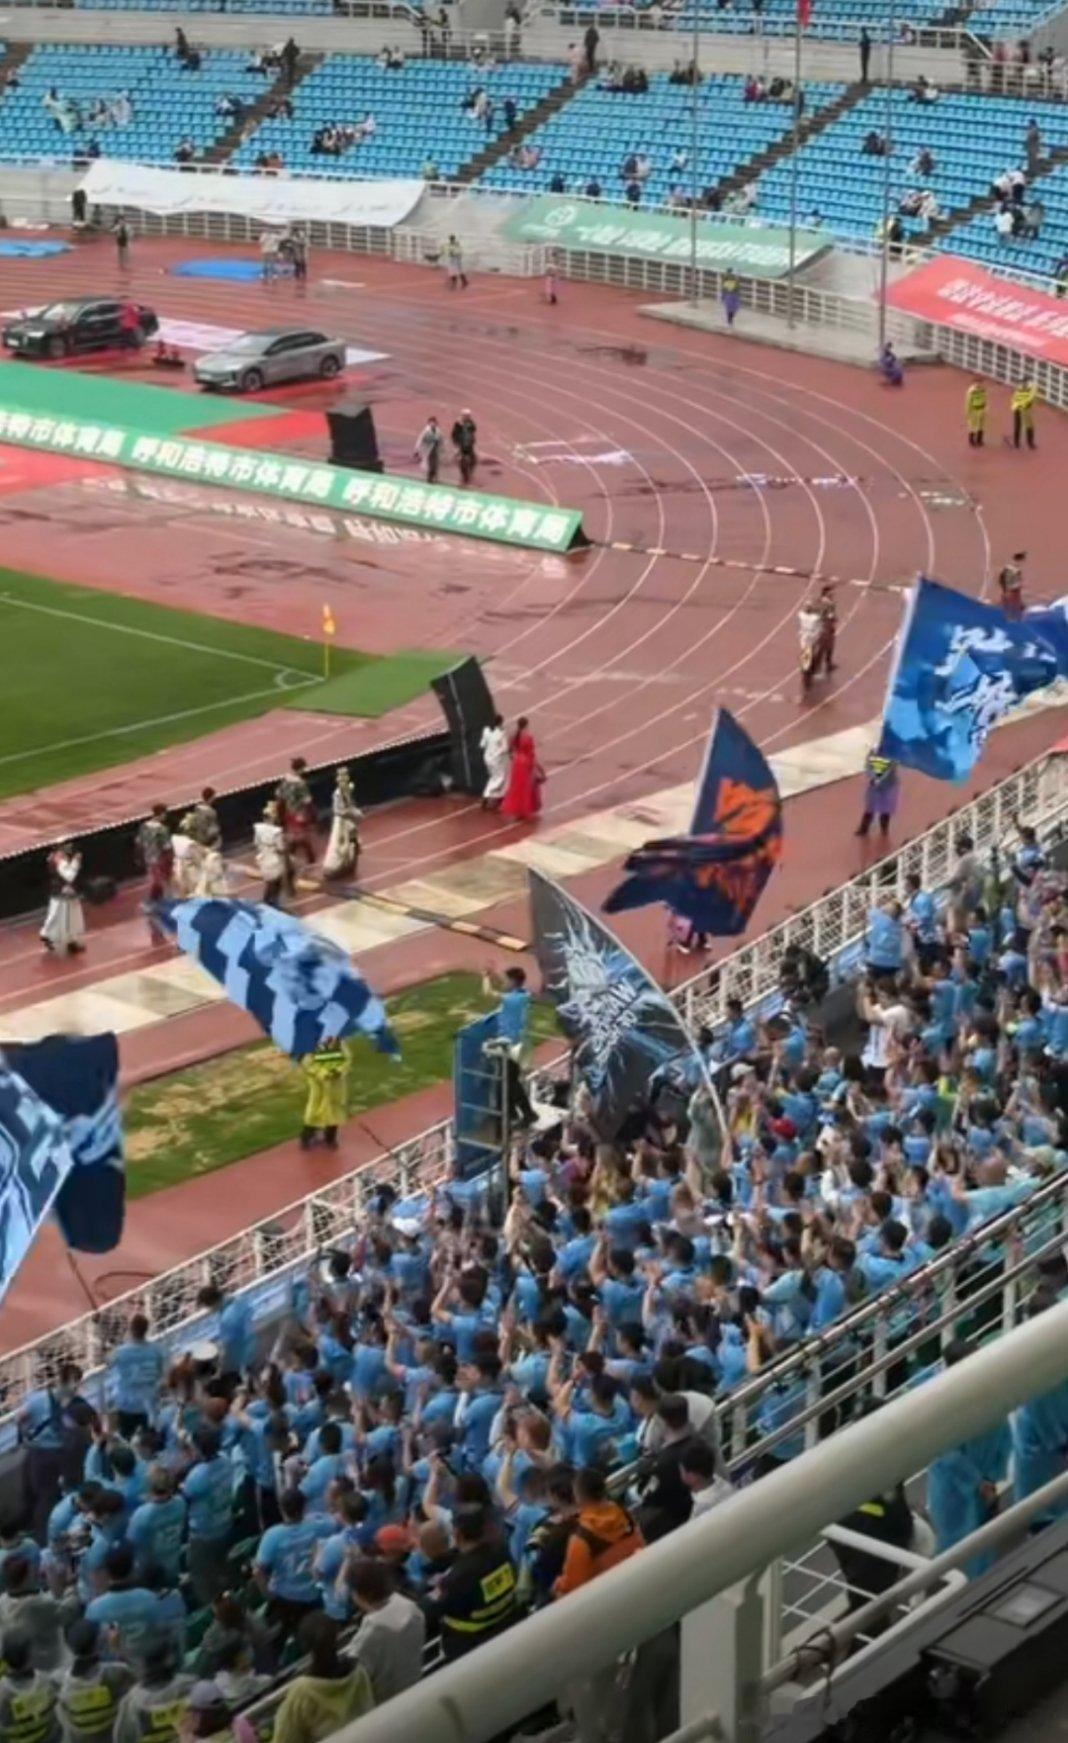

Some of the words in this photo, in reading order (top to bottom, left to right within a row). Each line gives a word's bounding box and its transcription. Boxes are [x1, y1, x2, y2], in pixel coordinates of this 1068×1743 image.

[341, 477, 571, 544] 呼和浩特市体育局
